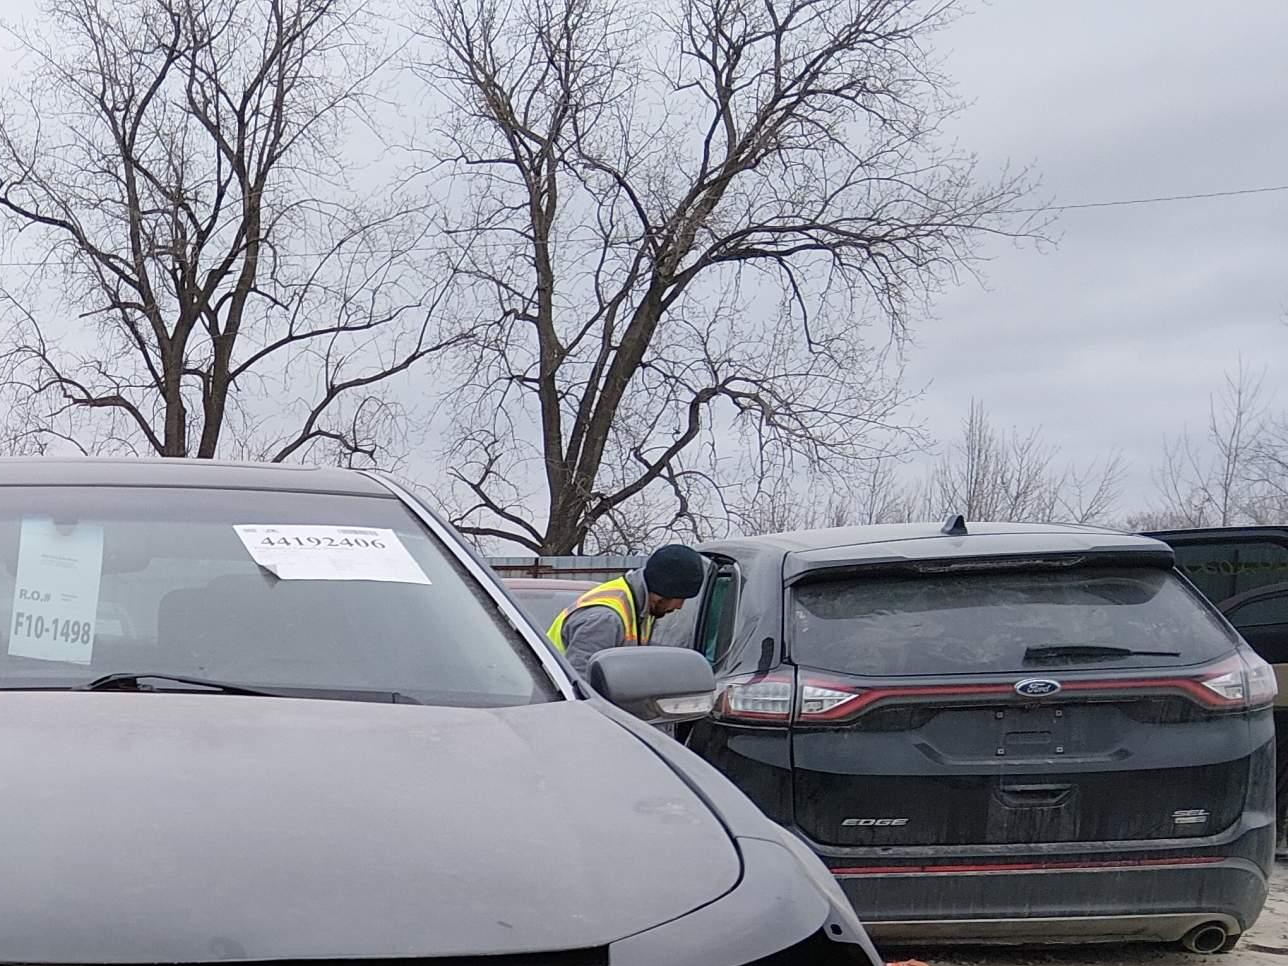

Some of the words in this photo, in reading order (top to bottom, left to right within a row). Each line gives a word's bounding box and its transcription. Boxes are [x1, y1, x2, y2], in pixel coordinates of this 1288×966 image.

[260, 536, 386, 550] 44192406
[14, 611, 92, 645] F10-1498
[841, 818, 909, 826] EDGE
